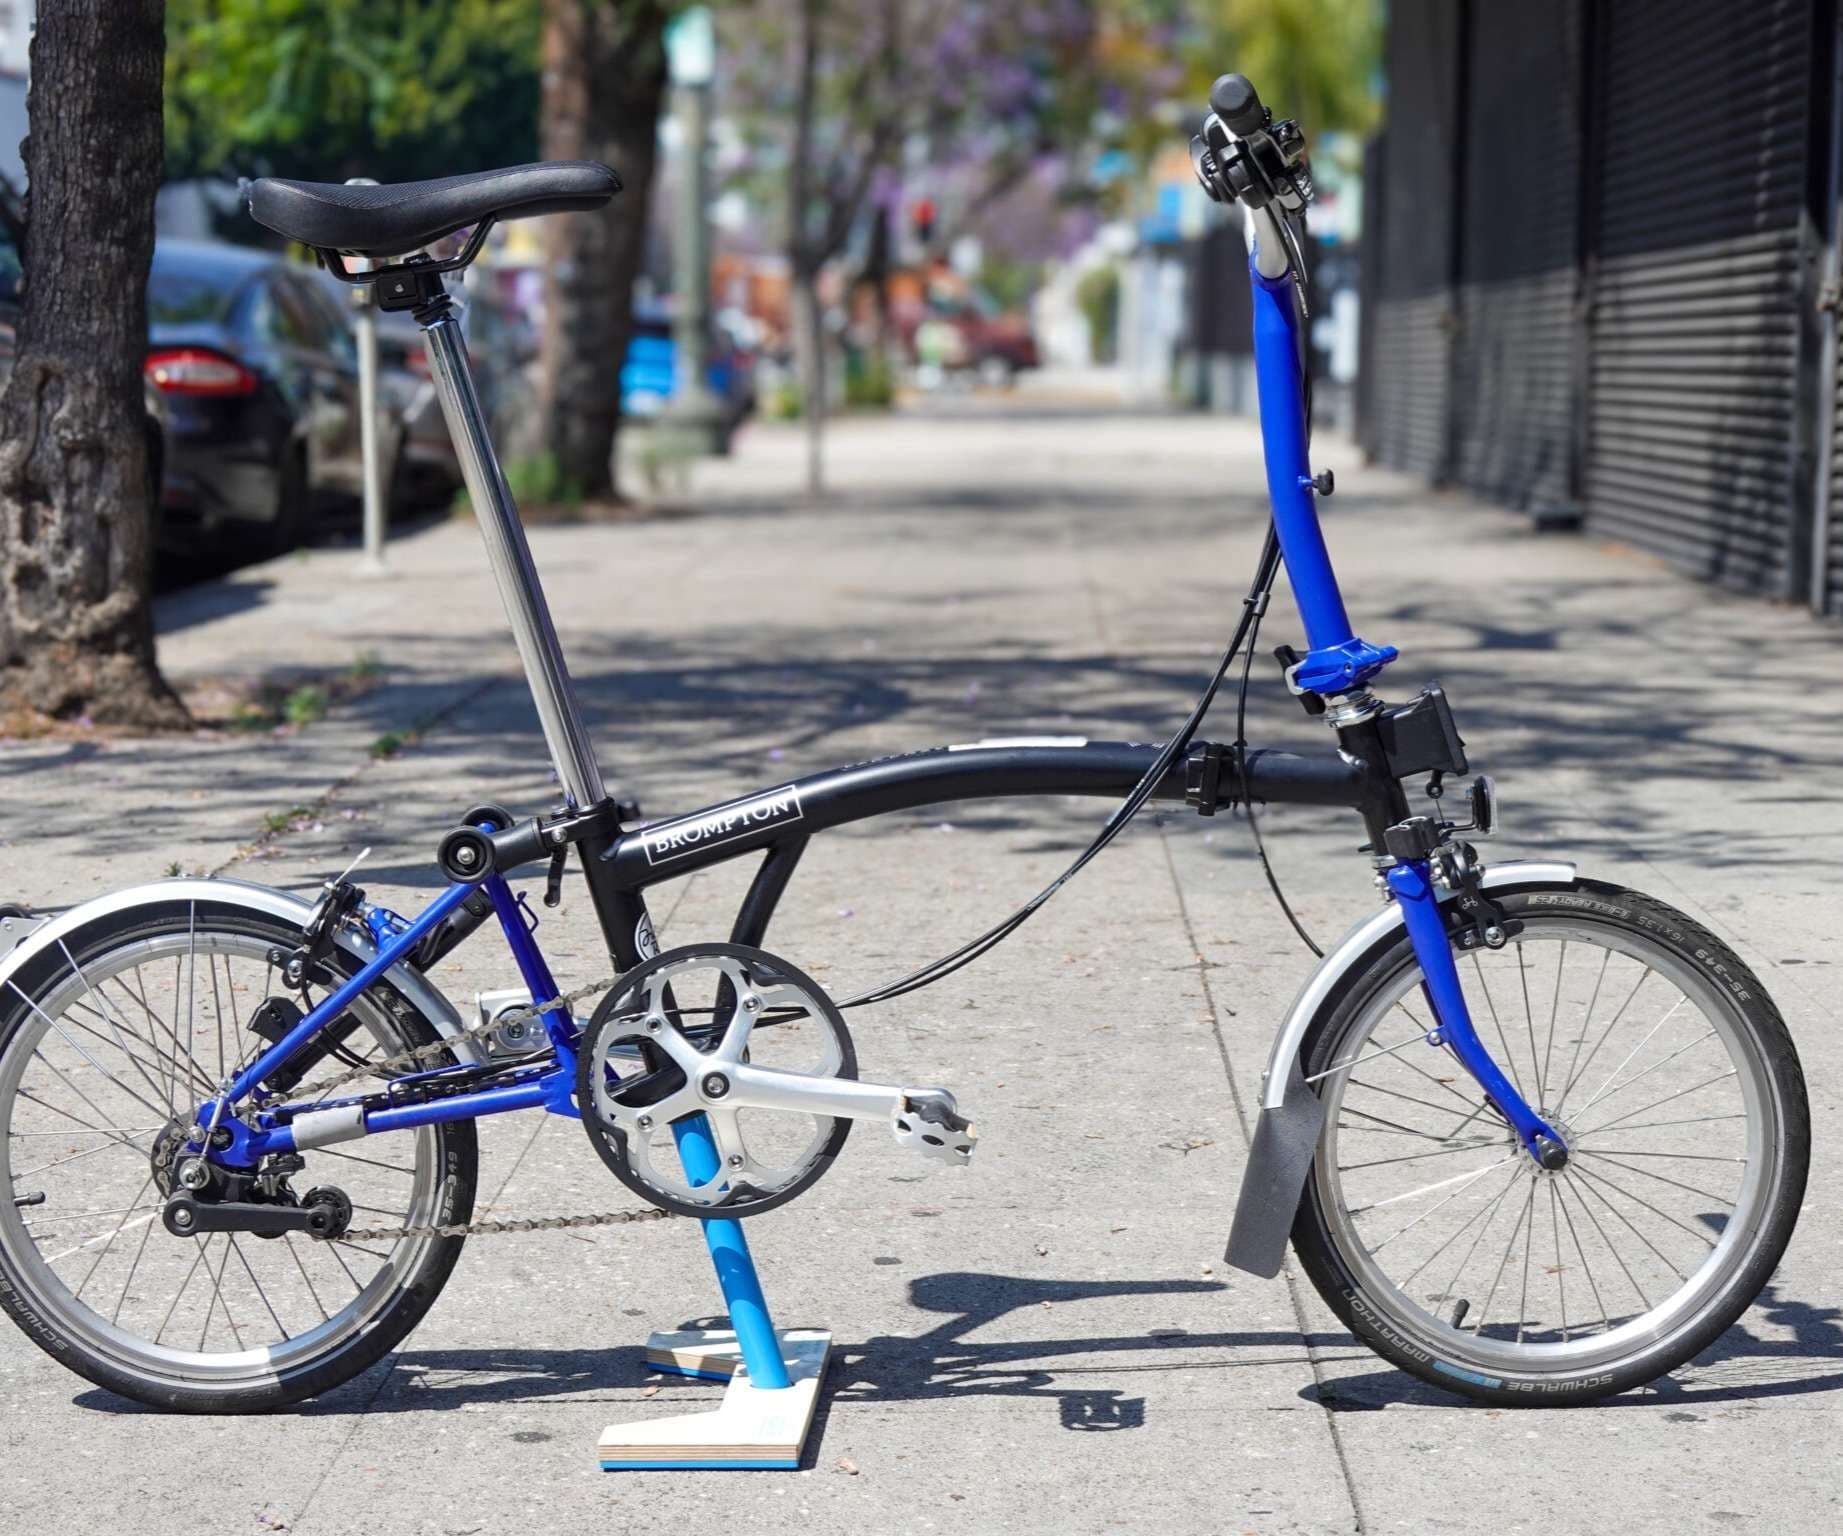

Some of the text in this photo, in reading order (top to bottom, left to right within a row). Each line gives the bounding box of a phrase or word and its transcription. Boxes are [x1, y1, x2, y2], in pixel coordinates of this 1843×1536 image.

[655, 792, 794, 853] BROMPTON
[1695, 949, 1751, 1000] 35-349
[442, 1151, 457, 1221] 35-349
[1342, 1287, 1431, 1362] MARATHON
[1507, 1373, 1614, 1392] SCHWALBE
